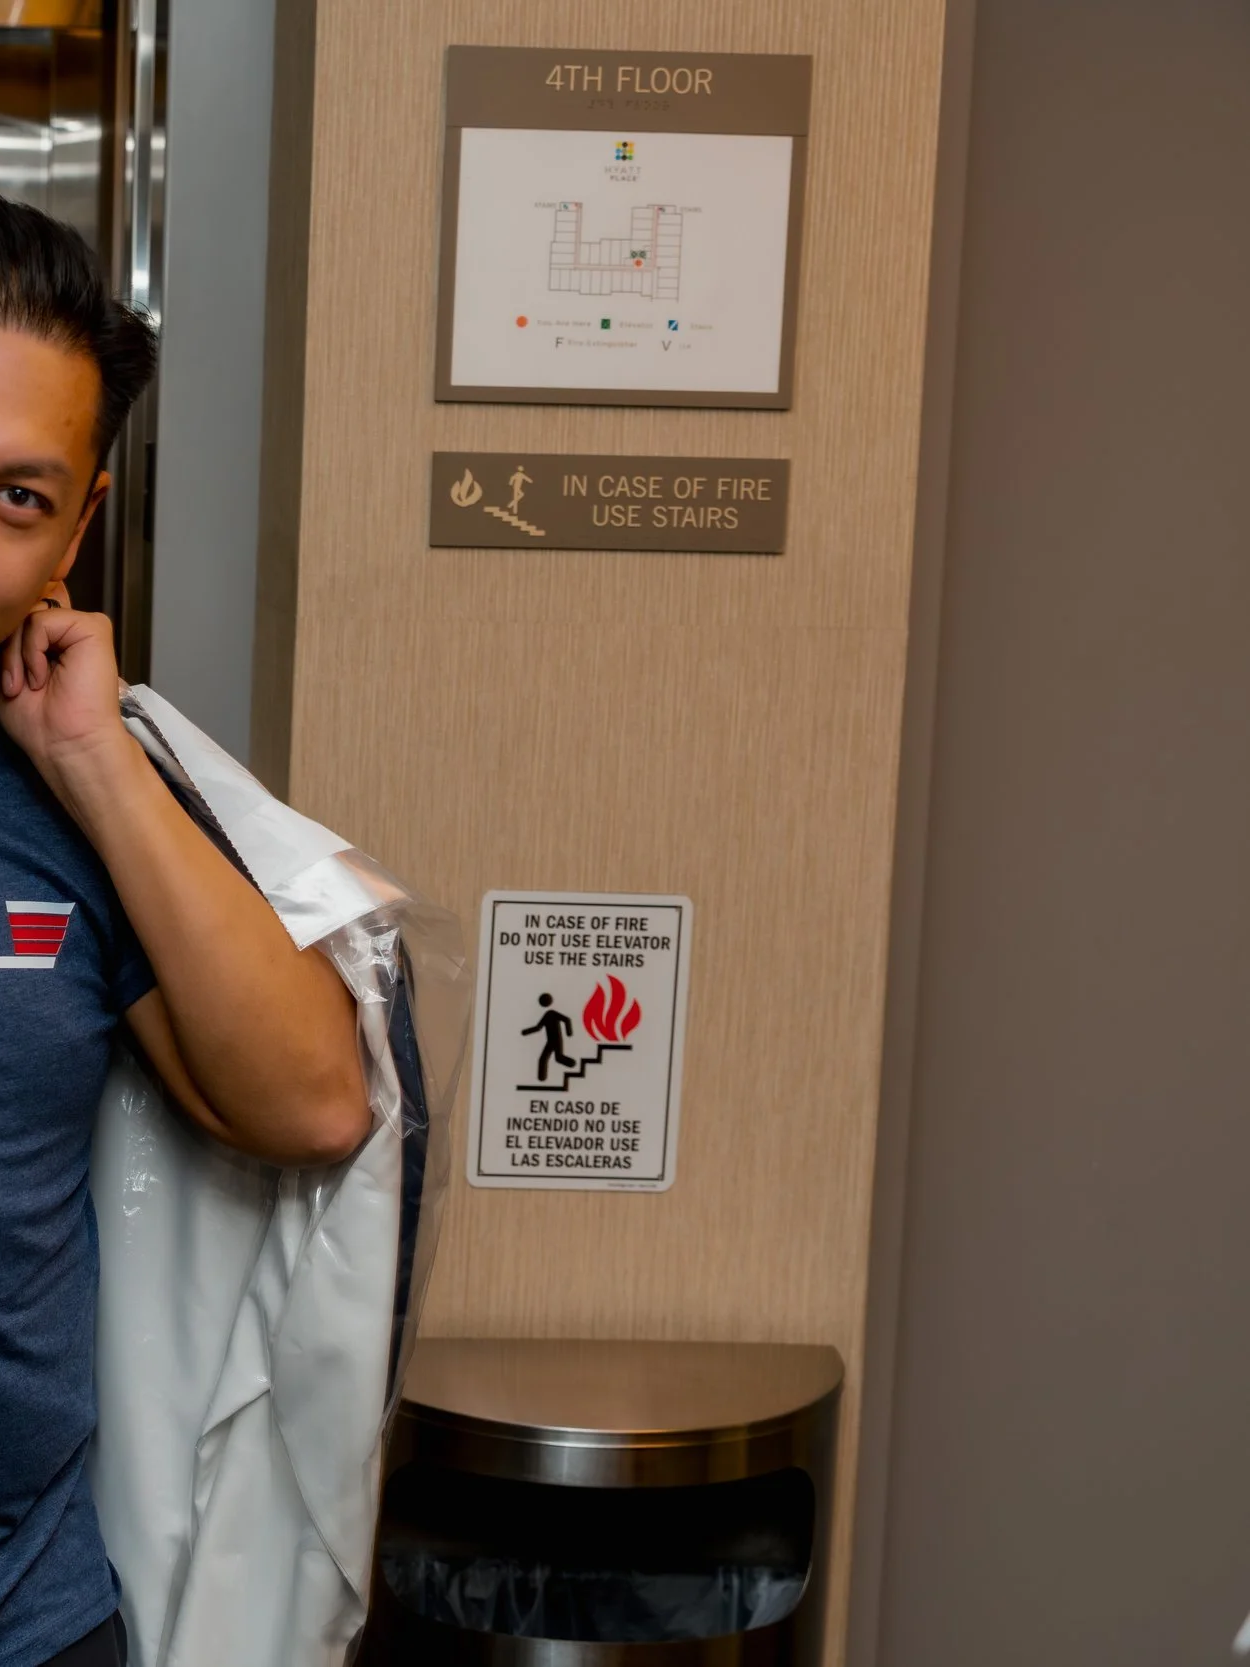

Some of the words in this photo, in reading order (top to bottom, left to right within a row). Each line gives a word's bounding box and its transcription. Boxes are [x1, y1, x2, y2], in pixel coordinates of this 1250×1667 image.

[545, 65, 602, 92] 4TH
[617, 66, 713, 95] FLOOR
[555, 337, 564, 348] F
[563, 475, 587, 497] IN
[598, 475, 663, 499] CASE
[673, 477, 707, 499] OF
[717, 478, 772, 501] FIRE
[592, 504, 642, 528] USE
[652, 506, 739, 530] STAIRS
[525, 914, 541, 928] IN
[546, 915, 586, 930] CASE
[590, 916, 611, 931] OF
[614, 917, 649, 931] FIRE
[500, 932, 520, 946] DO
[526, 933, 557, 947] NOT
[561, 934, 591, 948] USE
[596, 934, 671, 950] ELEVATOR
[524, 951, 554, 965] USE
[558, 952, 587, 966] THE
[592, 953, 645, 968] STAIRS
[530, 1100, 549, 1114] EN
[554, 1100, 595, 1115] CASO
[600, 1102, 621, 1116] DE
[506, 1117, 579, 1133] INCENDIO
[584, 1119, 605, 1133] NO
[611, 1120, 641, 1134] USE
[505, 1135, 522, 1149] EL
[527, 1135, 605, 1151] ELEVADOR
[610, 1137, 640, 1152] USE
[511, 1153, 540, 1167] LAS
[545, 1154, 632, 1169] ESCALERAS
